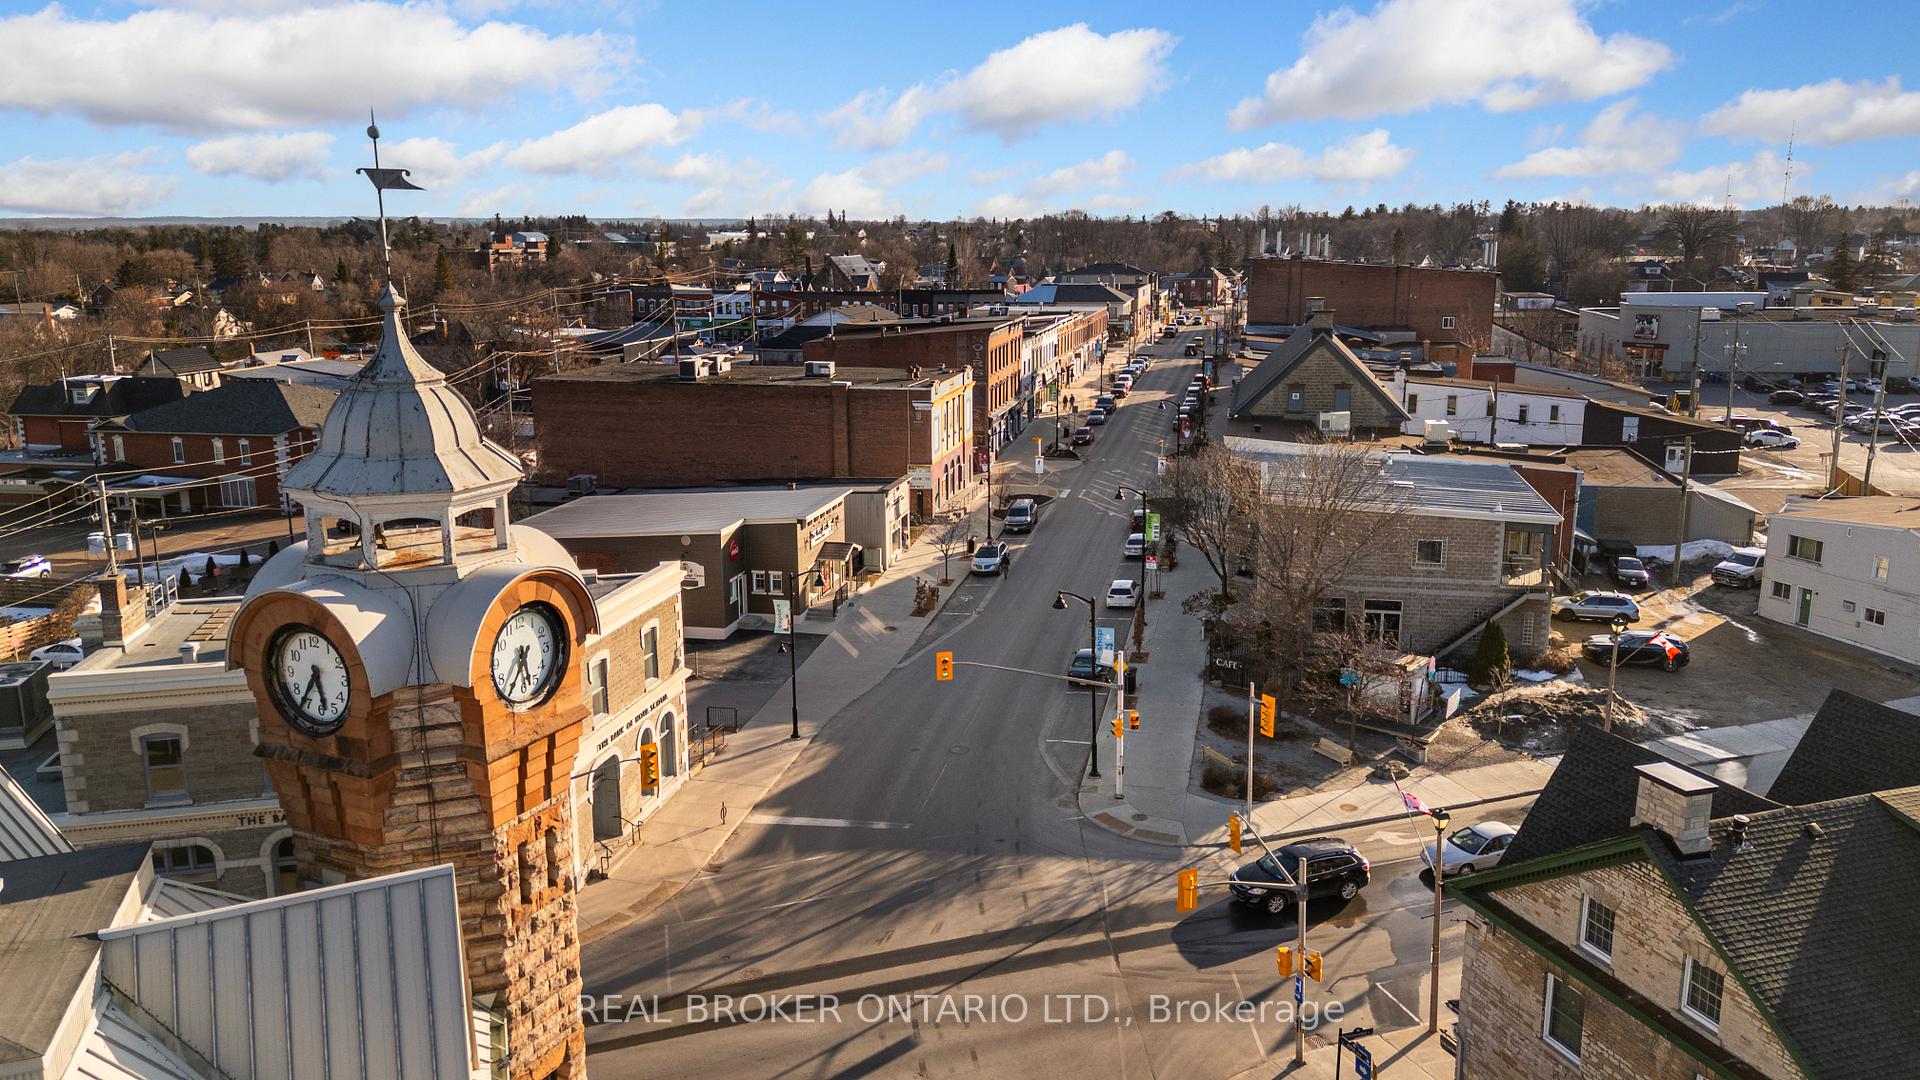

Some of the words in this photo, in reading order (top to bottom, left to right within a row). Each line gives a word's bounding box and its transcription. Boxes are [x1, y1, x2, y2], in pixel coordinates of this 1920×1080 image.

[515, 616, 525, 630] 12
[505, 624, 513, 636] 11
[538, 626, 545, 639] 2
[298, 638, 307, 650] 11
[309, 636, 320, 648] 12
[497, 639, 506, 652] 10
[542, 641, 550, 654] 3
[291, 650, 300, 662] 10
[335, 656, 344, 670] 2
[538, 658, 545, 670] 4
[288, 665, 294, 678] 9
[341, 675, 349, 688] 3
[498, 673, 504, 686] 8
[532, 674, 538, 686] 5
[294, 682, 300, 695] 8
[336, 691, 345, 703] 4
[318, 704, 326, 716] 6
[330, 702, 338, 715] 5
[238, 815, 266, 826] THE
